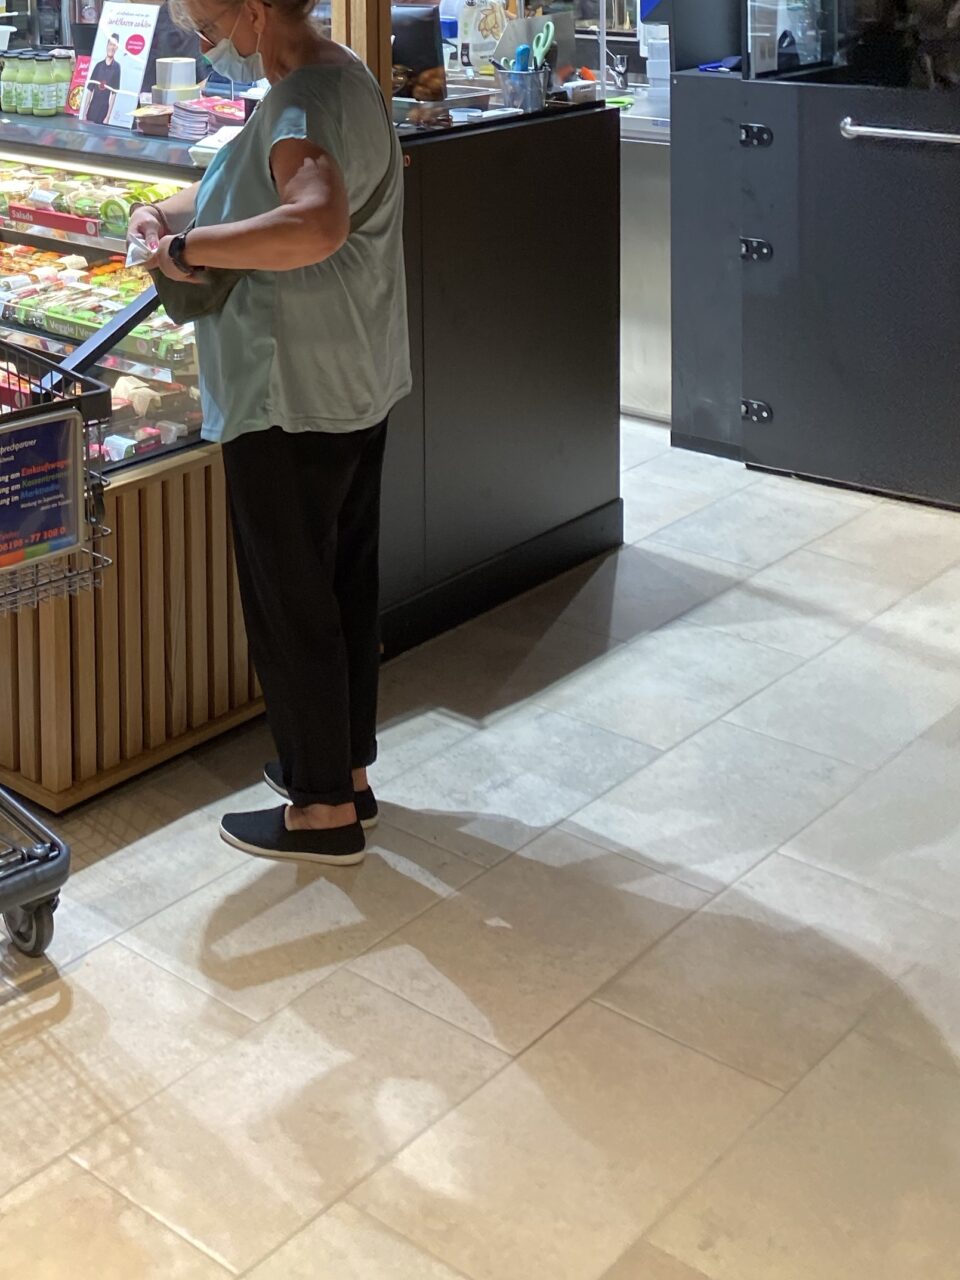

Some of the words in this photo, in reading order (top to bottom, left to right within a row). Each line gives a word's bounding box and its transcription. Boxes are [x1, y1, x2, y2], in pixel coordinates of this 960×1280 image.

[11, 209, 33, 222] Salads
[10, 472, 20, 480] am
[31, 533, 42, 543] 77
